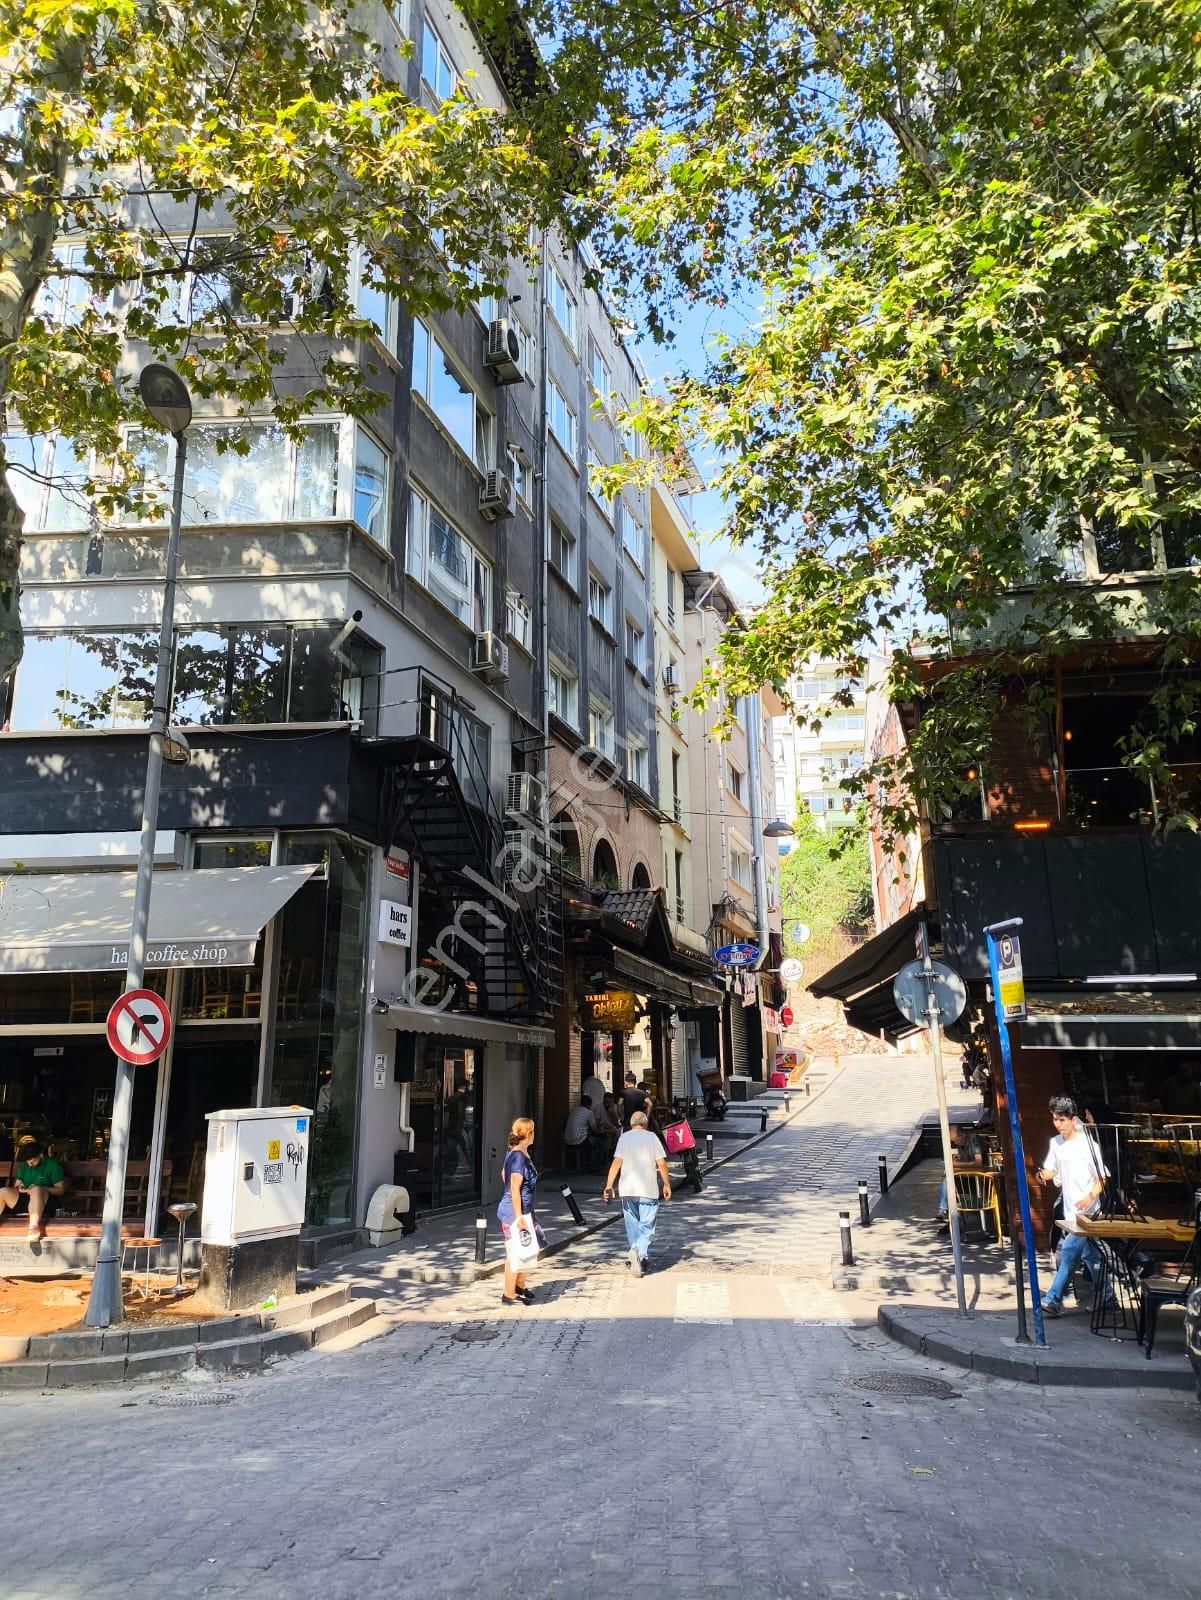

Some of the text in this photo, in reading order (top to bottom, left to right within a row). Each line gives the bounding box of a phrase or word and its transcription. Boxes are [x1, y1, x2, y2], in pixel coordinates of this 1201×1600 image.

[390, 905, 408, 924] hars
[389, 927, 407, 941] coffee
[146, 944, 188, 963] coffee
[191, 944, 228, 964] shop
[674, 1128, 684, 1144] Y
